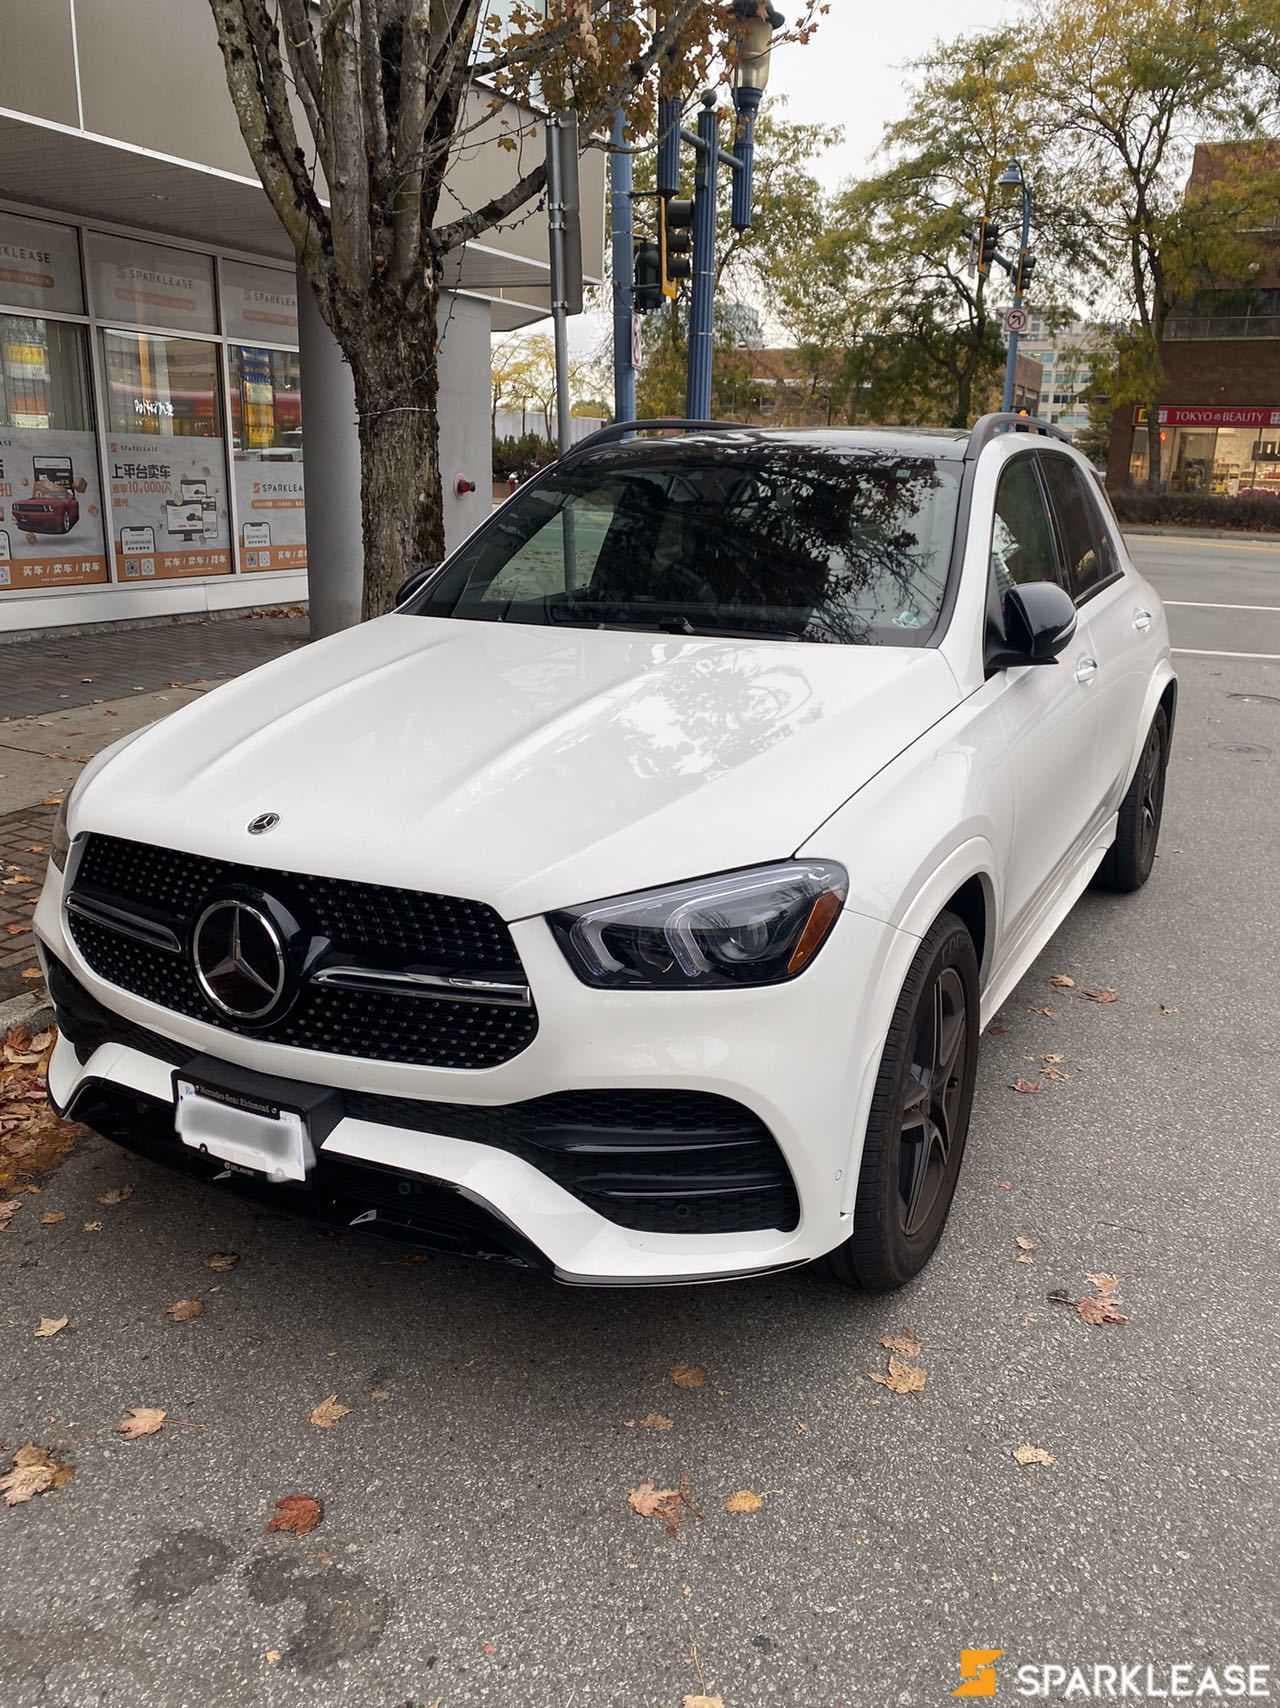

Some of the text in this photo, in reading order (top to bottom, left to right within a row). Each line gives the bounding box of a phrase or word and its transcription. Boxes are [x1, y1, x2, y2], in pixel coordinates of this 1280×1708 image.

[1176, 411, 1264, 422] TOKYO BEAUTY
[112, 464, 171, 479] 上平台卖车
